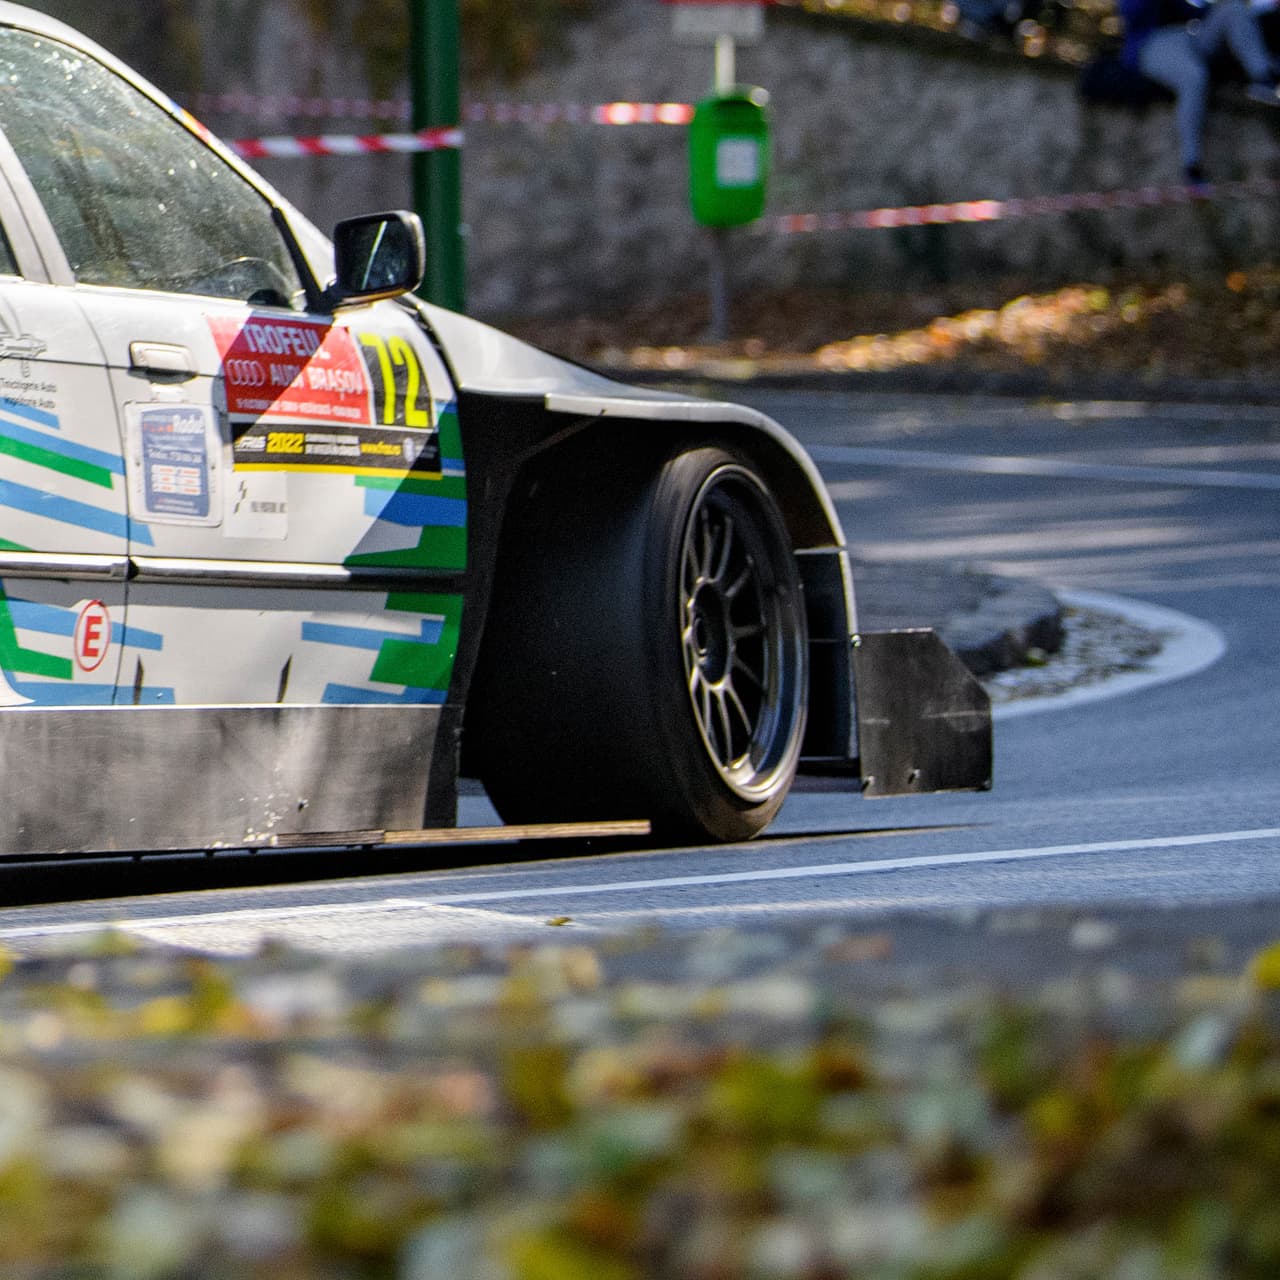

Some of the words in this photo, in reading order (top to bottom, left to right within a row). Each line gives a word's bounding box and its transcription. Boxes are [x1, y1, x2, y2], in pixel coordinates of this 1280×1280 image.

[243, 323, 331, 361] TROFEUL
[357, 332, 429, 428] 72
[266, 432, 305, 454] 2022
[82, 615, 104, 657] E
